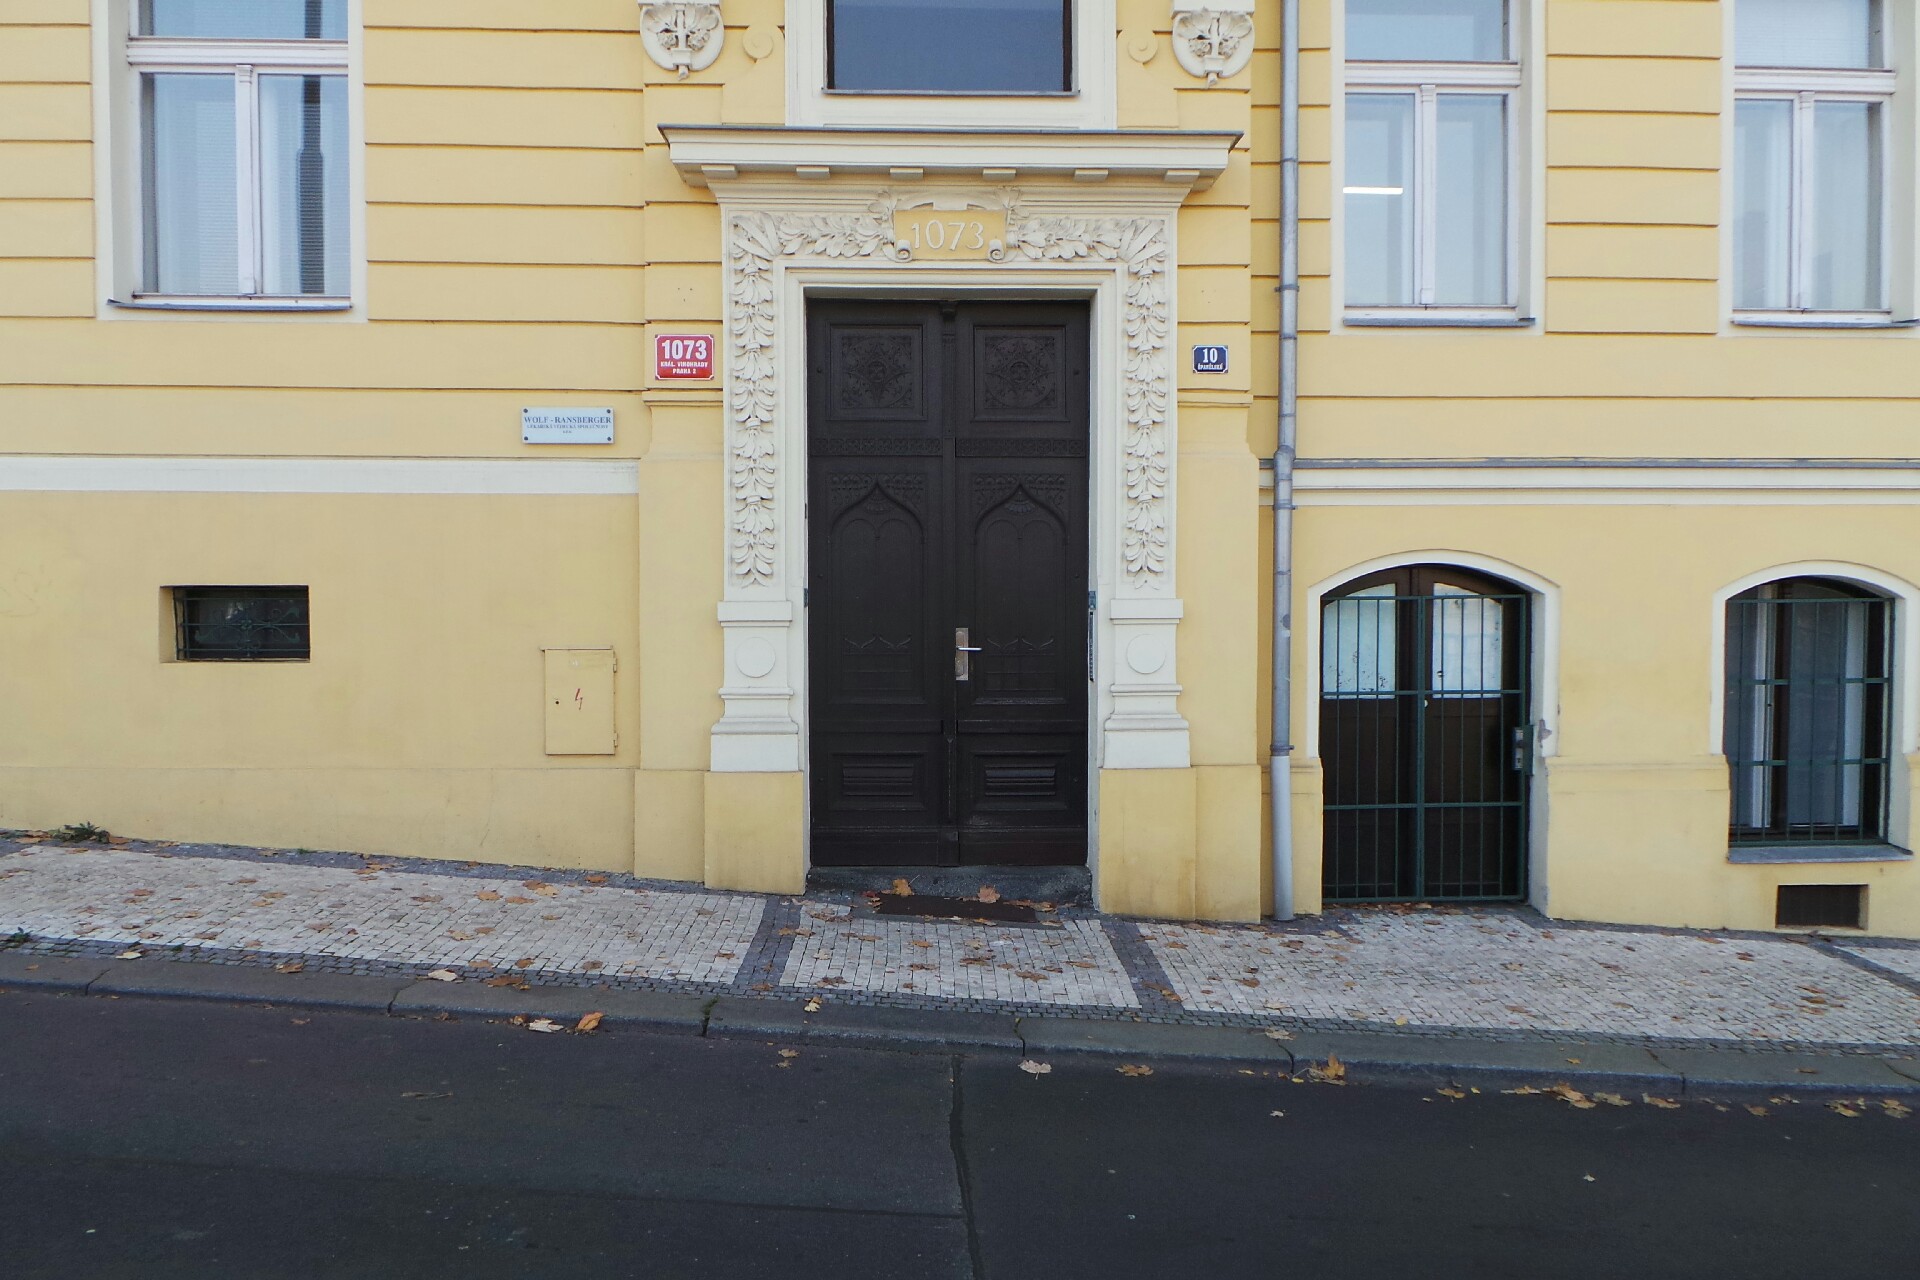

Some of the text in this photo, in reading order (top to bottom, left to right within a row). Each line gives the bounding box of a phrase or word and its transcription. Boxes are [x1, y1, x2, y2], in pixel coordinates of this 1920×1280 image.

[911, 219, 985, 251] 1073
[661, 339, 707, 360] 1073
[1202, 348, 1218, 363] 10
[524, 416, 549, 424] WOLF
[555, 416, 612, 424] RANSBERGER
